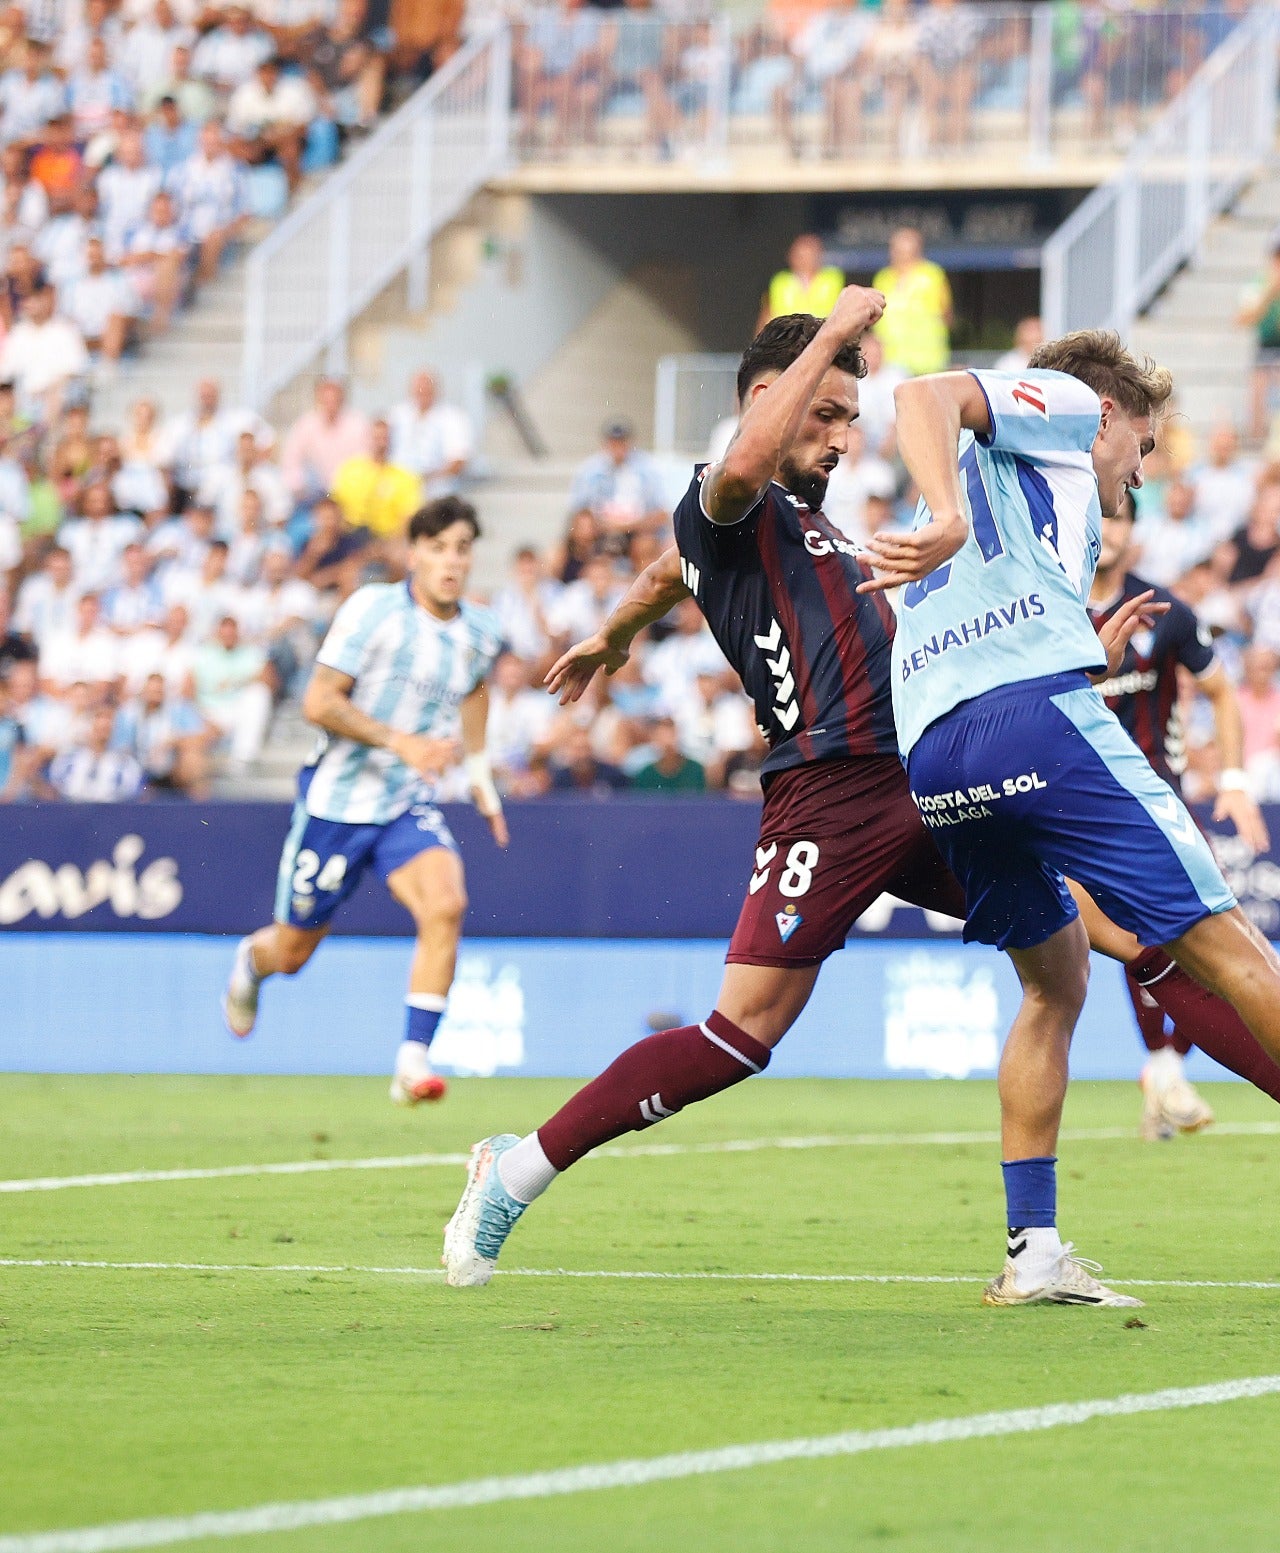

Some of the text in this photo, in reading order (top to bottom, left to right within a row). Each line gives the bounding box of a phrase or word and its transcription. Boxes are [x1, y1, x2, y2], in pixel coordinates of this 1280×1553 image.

[903, 593, 1046, 683] BENAHAVIS
[919, 771, 1047, 812] COSTA DEL SOL
[0, 833, 183, 925] avis
[294, 848, 347, 896] 24
[778, 840, 820, 898] 8
